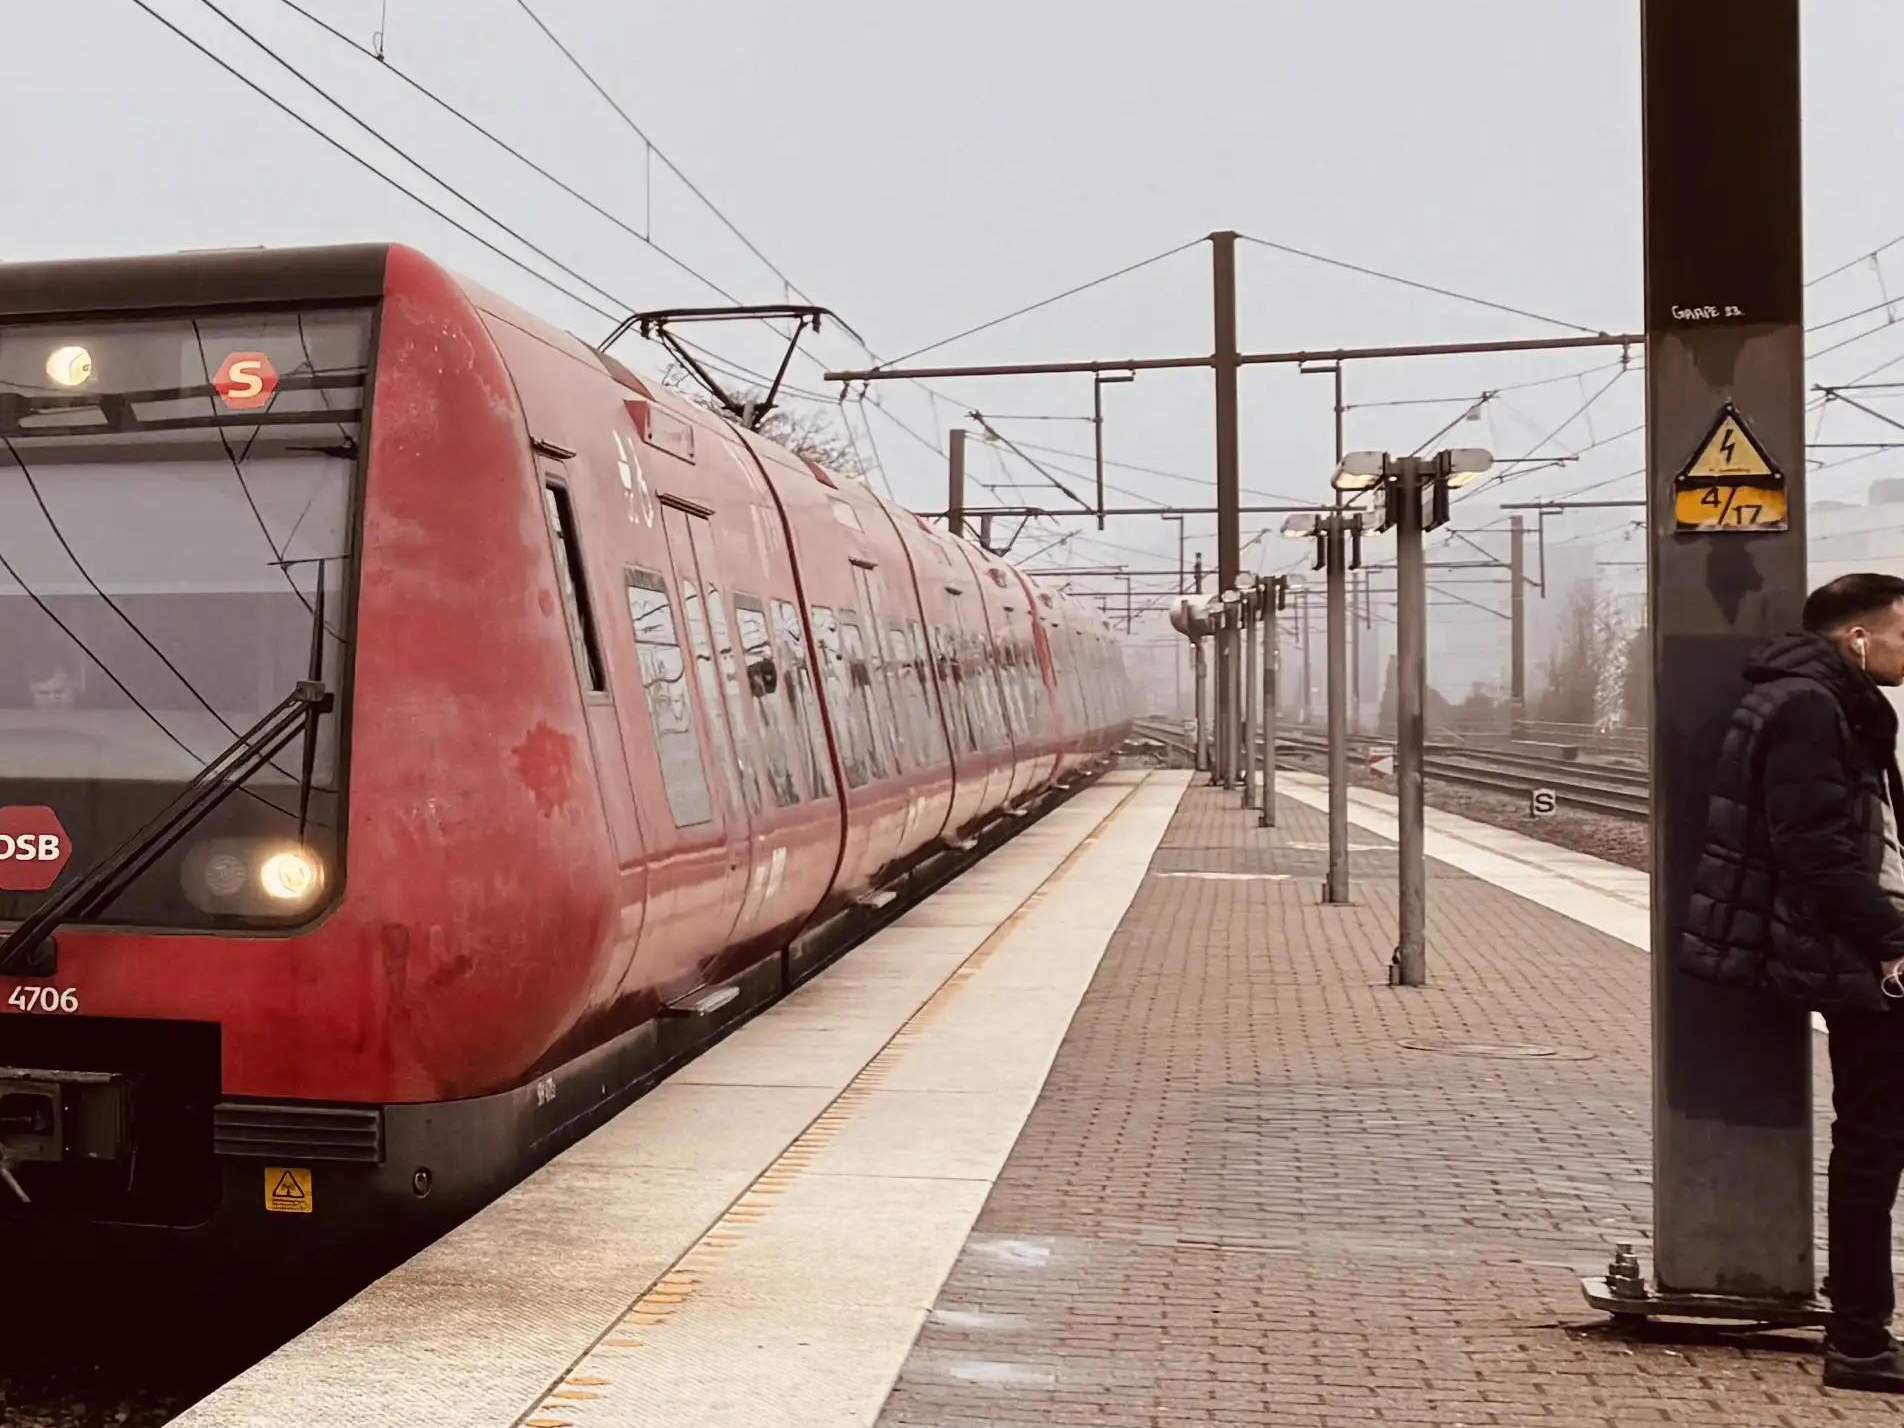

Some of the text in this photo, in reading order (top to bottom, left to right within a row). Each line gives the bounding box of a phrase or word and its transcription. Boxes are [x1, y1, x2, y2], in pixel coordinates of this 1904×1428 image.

[227, 360, 263, 398] S
[1700, 486, 1763, 526] 4/17
[1535, 792, 1555, 813] S
[8, 985, 79, 1013] 4706
